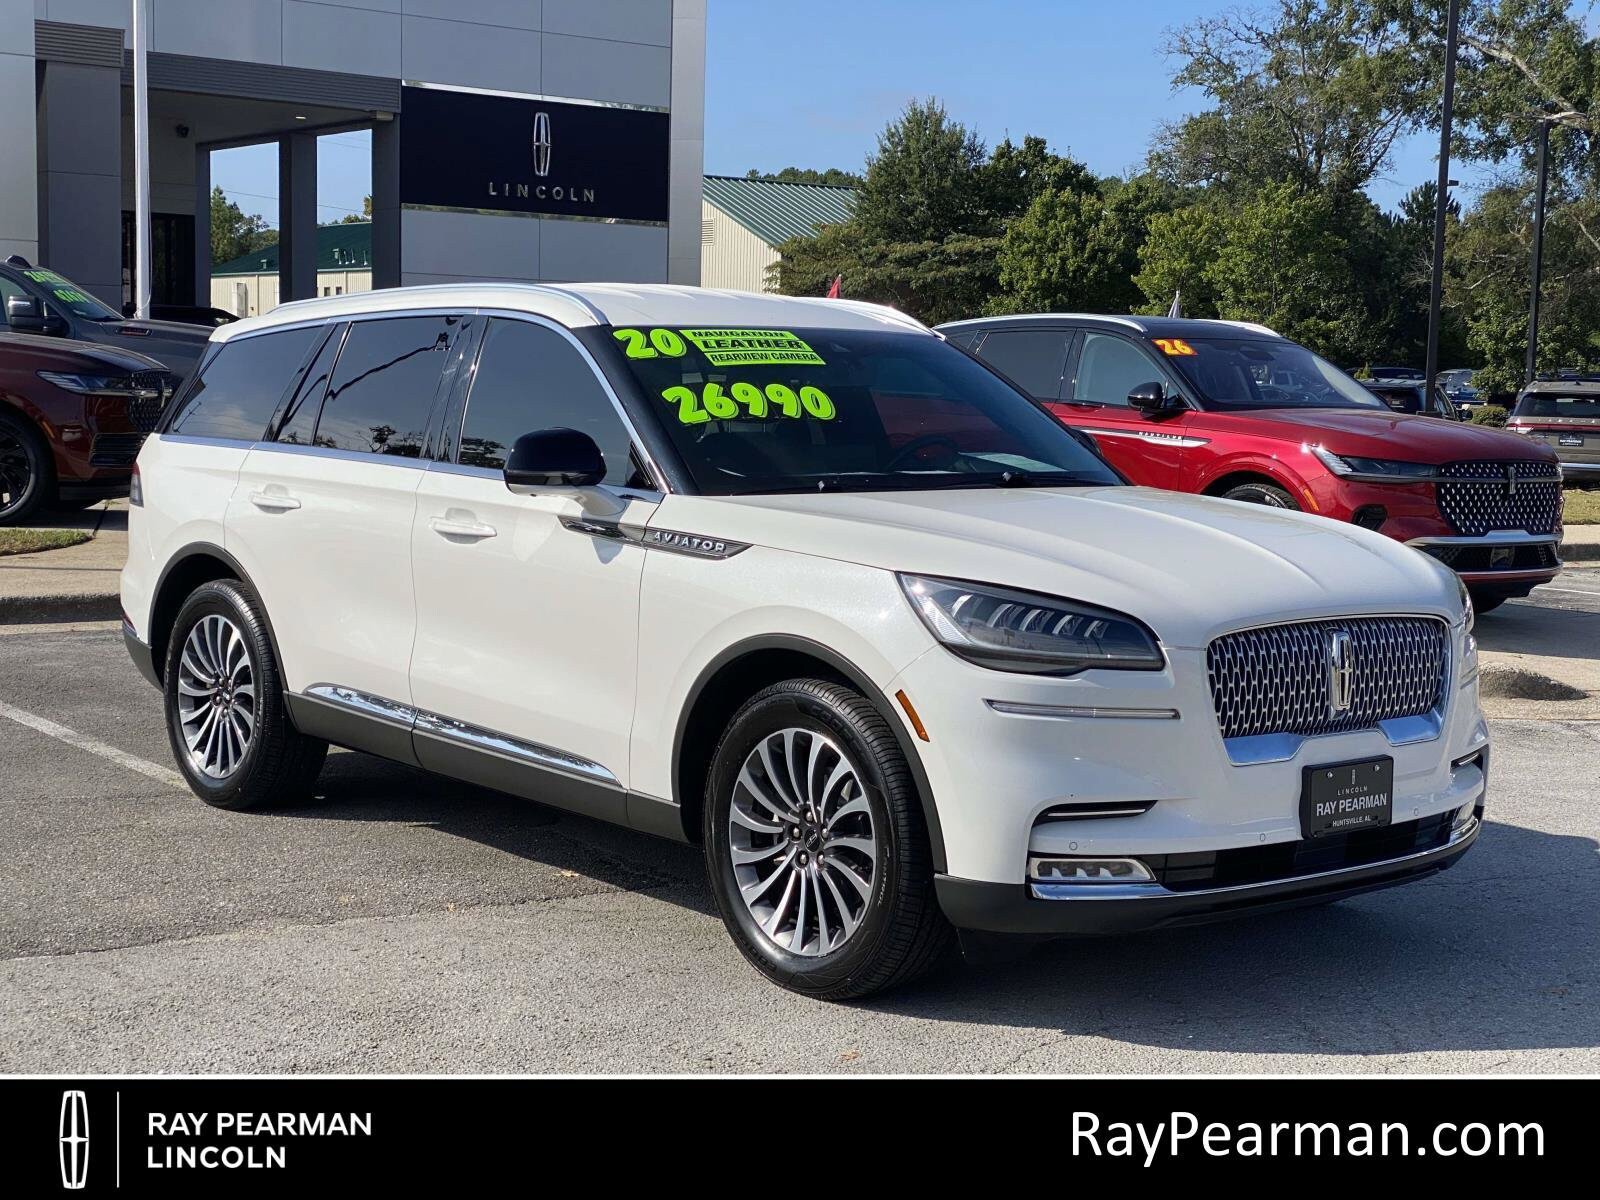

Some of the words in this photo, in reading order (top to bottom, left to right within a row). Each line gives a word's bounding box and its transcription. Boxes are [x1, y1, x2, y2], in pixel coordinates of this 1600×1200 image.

[488, 181, 595, 203] LINCOLN
[613, 328, 687, 359] 20
[691, 330, 785, 338] NAVIGATION
[701, 339, 802, 350] LEATHER
[1153, 339, 1195, 356] 26
[710, 352, 768, 363] REARVIEW
[771, 351, 818, 361] CAMERA
[661, 382, 836, 424] 26990
[653, 531, 727, 554] AVIATOR
[1337, 785, 1368, 796] LINCOLN
[1316, 801, 1337, 817] RAY
[1339, 793, 1387, 812] PEARMAN
